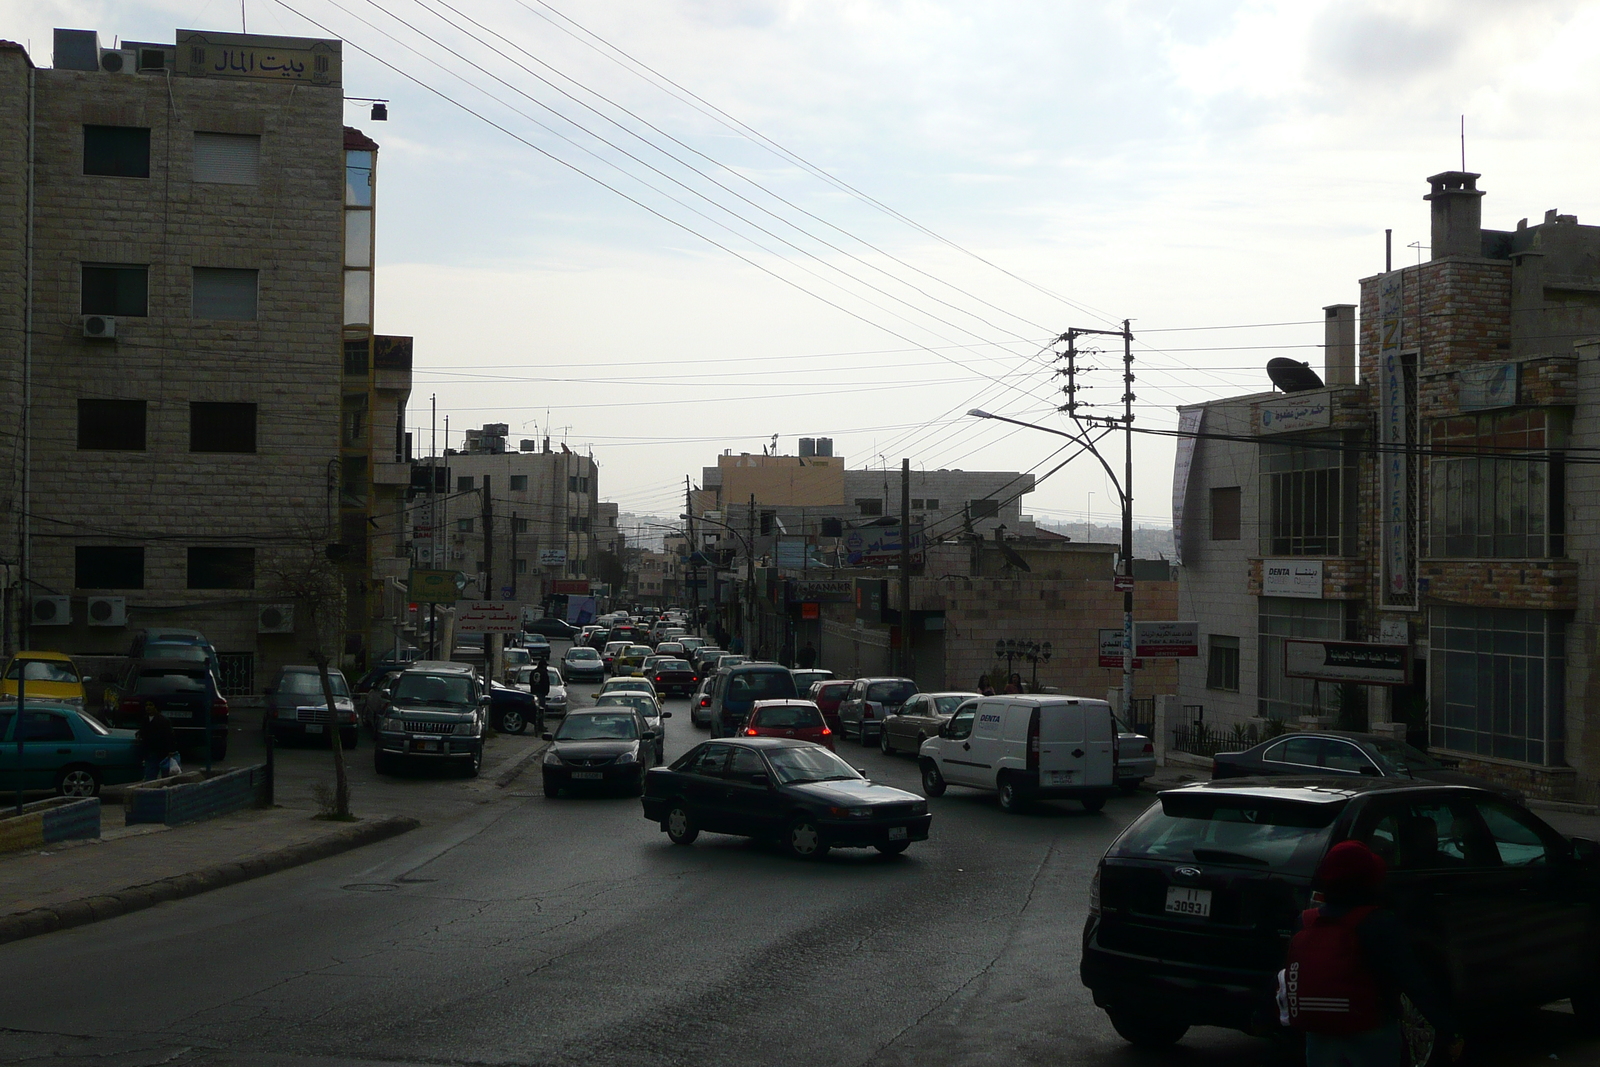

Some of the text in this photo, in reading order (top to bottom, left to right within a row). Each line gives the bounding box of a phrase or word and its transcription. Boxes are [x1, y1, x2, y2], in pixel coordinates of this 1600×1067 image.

[214, 49, 254, 73] المال
[259, 56, 305, 78] بيت
[1386, 355, 1400, 423] CAFE
[1268, 567, 1290, 576] DENTA
[488, 612, 518, 622] موقف
[979, 714, 1001, 723] DENTA
[1173, 900, 1207, 915] 30931
[1286, 961, 1300, 1018] adidas
